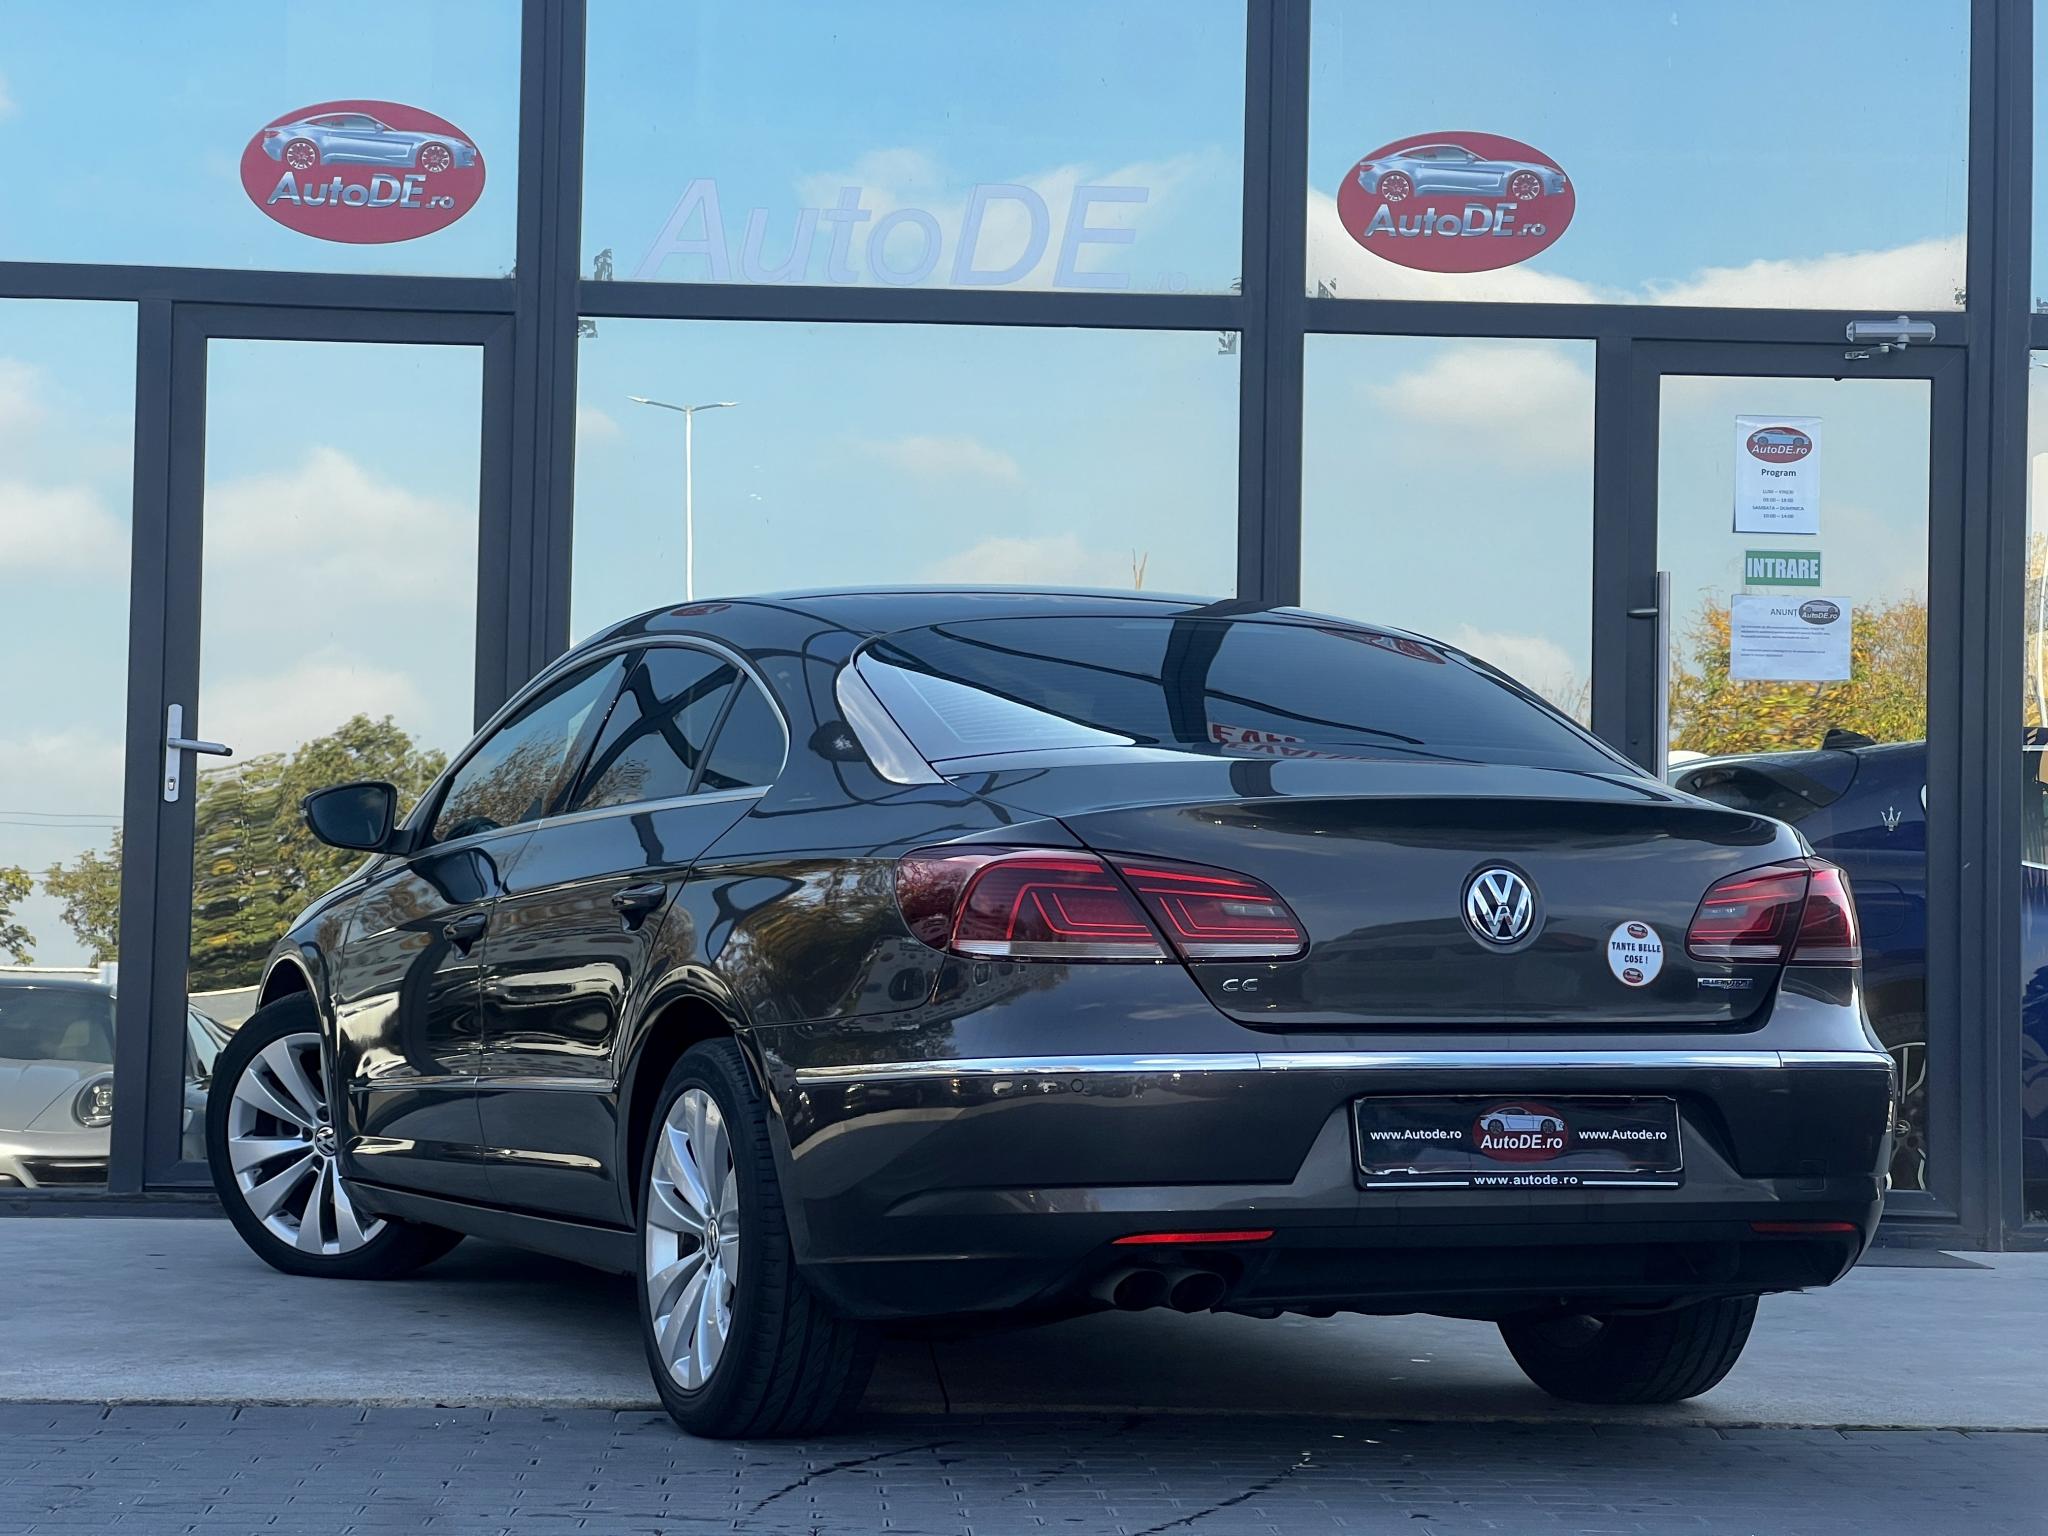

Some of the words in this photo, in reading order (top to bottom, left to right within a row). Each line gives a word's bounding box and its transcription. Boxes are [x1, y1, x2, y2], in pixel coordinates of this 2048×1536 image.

[1751, 445, 1808, 455] AutoDE.ro
[1761, 468, 1797, 478] Program
[1746, 557, 1819, 579] INTRARE
[1611, 941, 1636, 952] TANTE
[1638, 943, 1662, 953] BELLE
[1624, 954, 1644, 964] COSE
[1222, 978, 1259, 992] CC
[1369, 1128, 1463, 1141] www.Autode.ro
[1480, 1133, 1564, 1150] AutoDE.ro
[1577, 1128, 1668, 1141] www.Autode.ro
[1473, 1174, 1579, 1186] www.autode.ro
